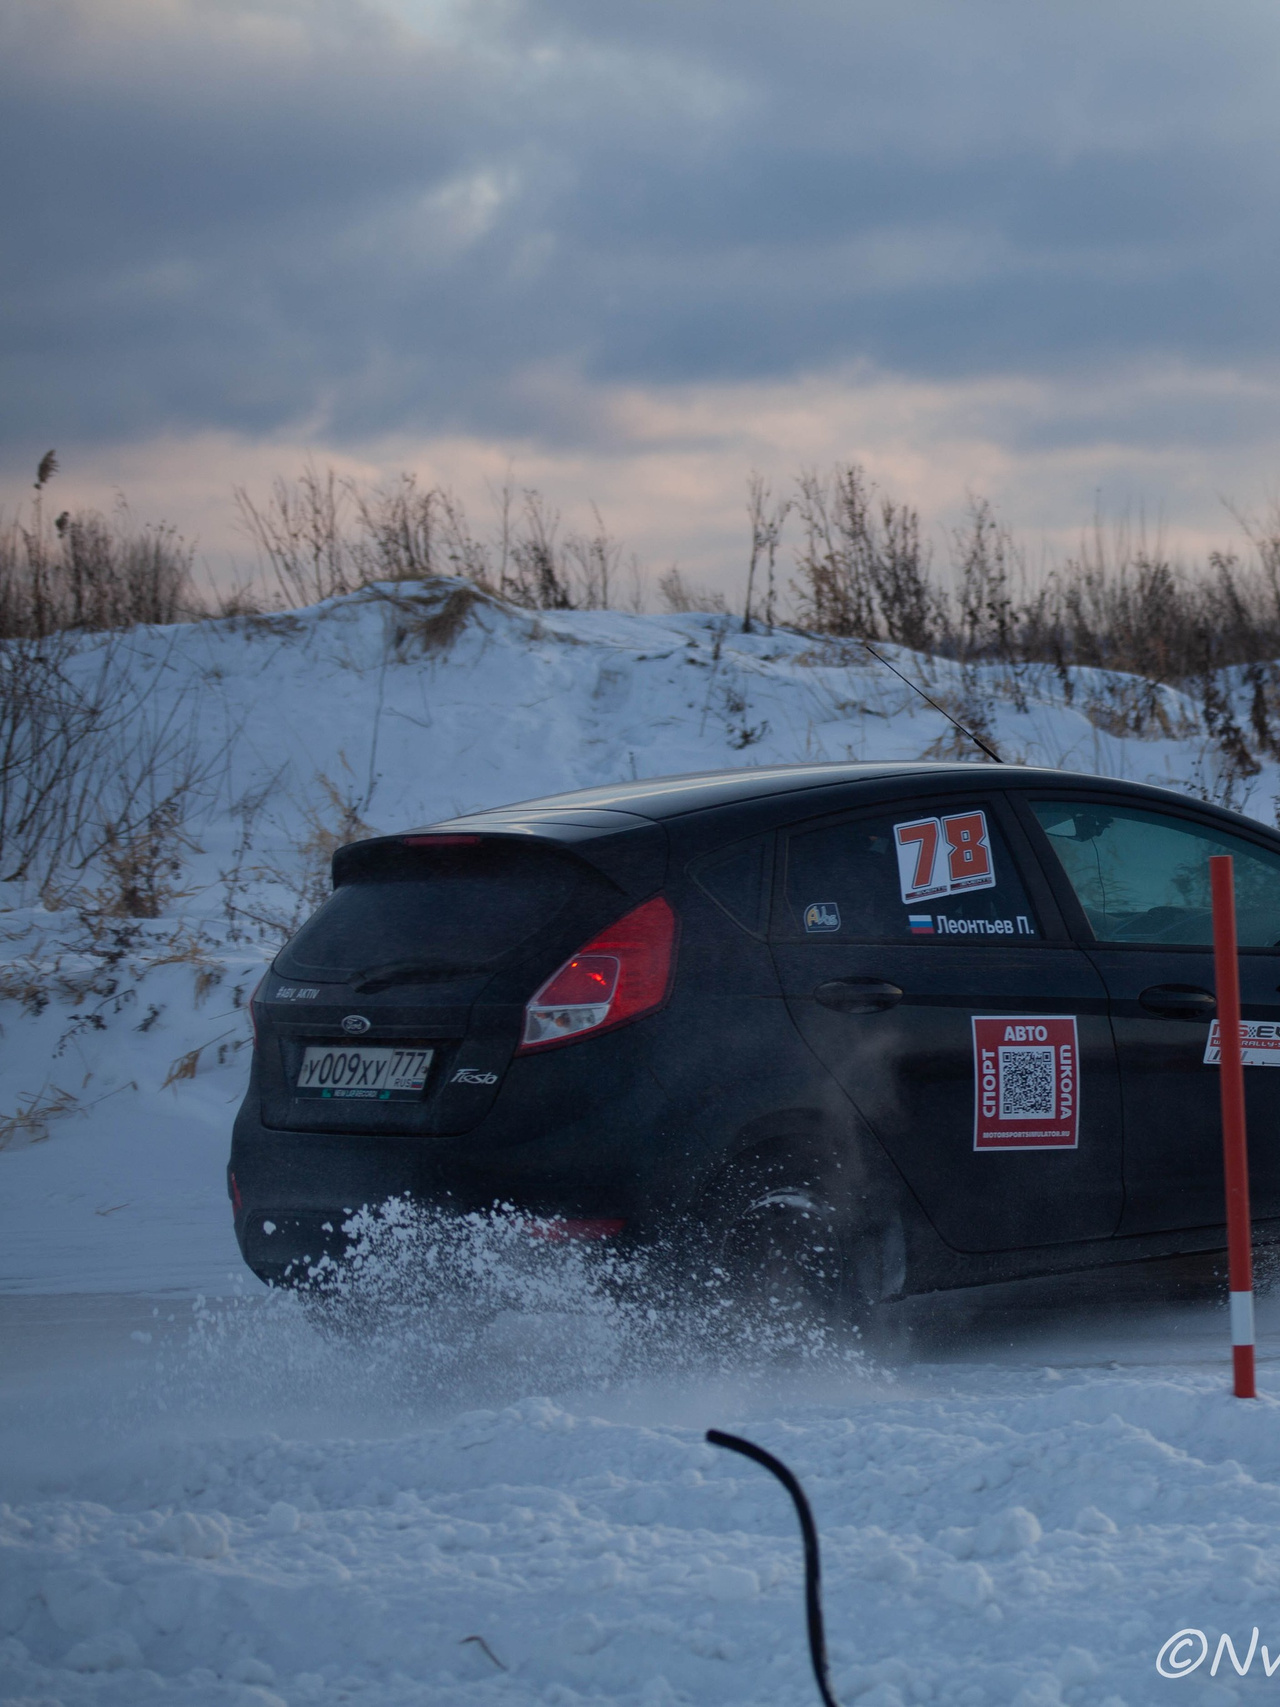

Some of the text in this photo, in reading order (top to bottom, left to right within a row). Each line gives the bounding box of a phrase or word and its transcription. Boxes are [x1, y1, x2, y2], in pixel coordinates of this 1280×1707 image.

[897, 812, 990, 889] 78
[936, 915, 1035, 934] Леонтьев П.
[1004, 1025, 1048, 1041] АВТО
[391, 1051, 427, 1078] 777
[393, 1078, 411, 1088] RUS
[450, 1068, 498, 1085] Fiesta
[981, 1048, 996, 1118] СПОРТ
[1060, 1045, 1073, 1120] ШКОЛА
